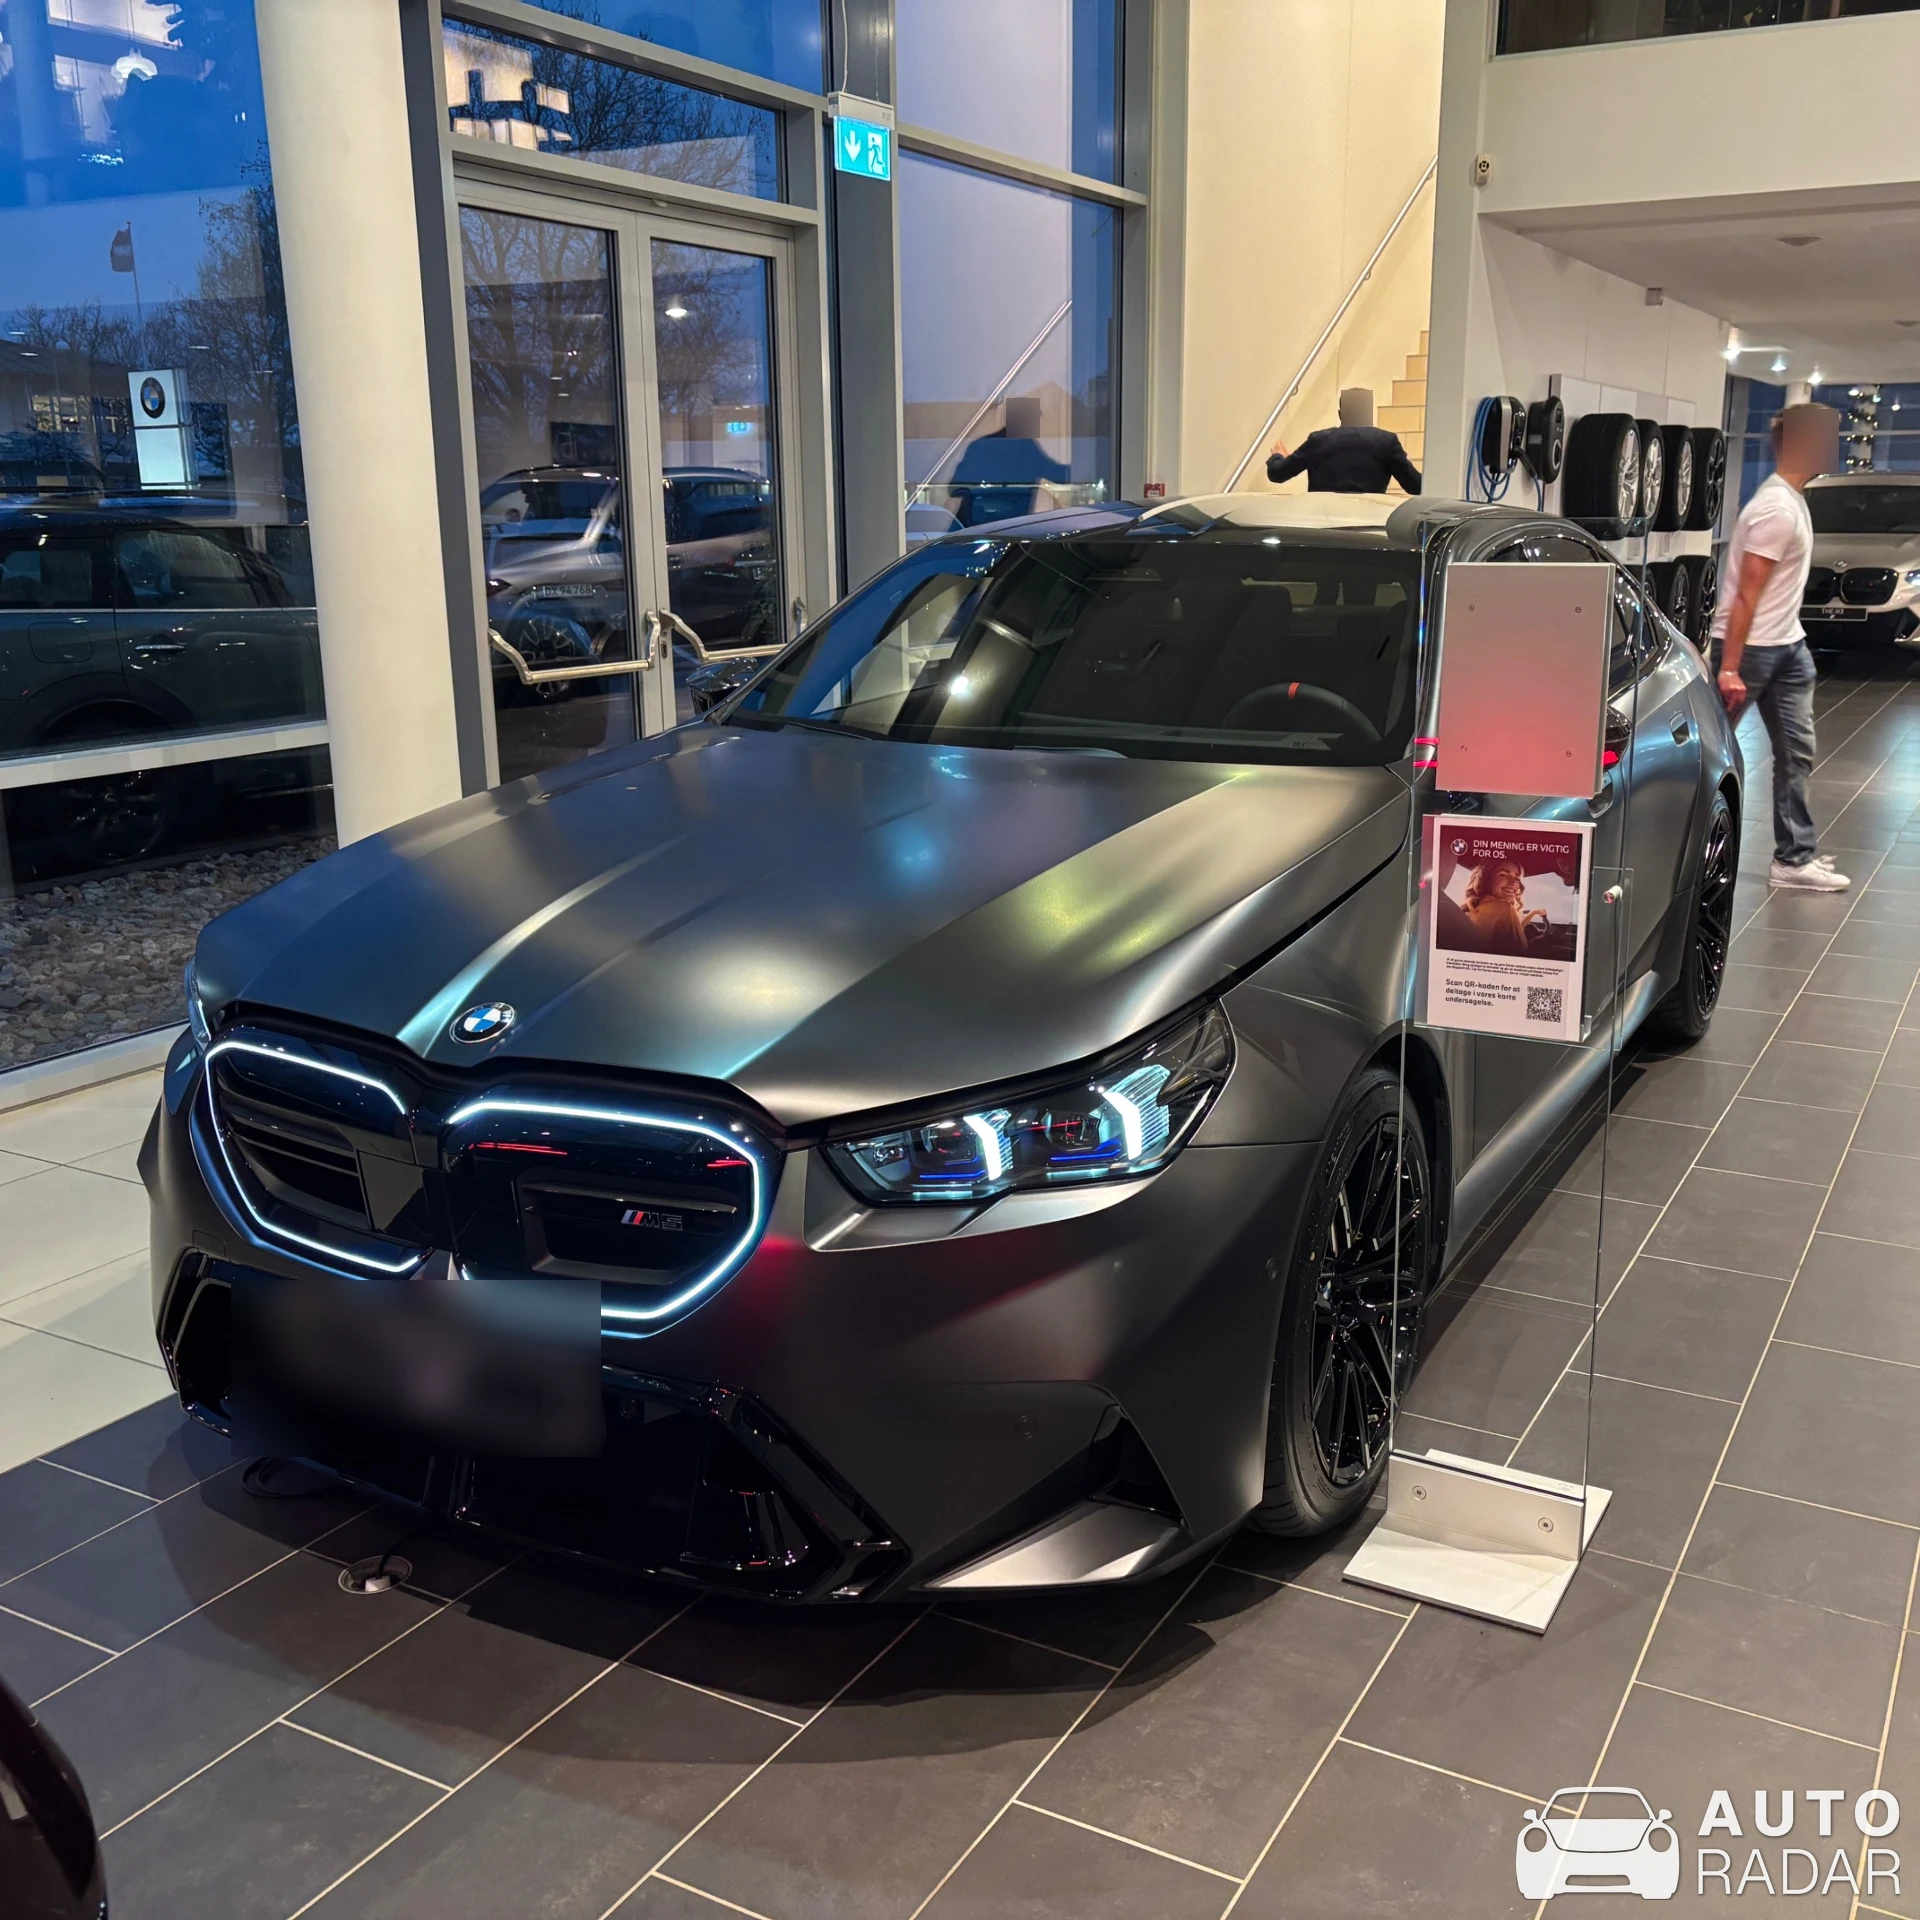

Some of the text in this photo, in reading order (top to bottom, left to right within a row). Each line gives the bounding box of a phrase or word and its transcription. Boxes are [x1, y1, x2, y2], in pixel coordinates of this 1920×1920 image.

[1473, 840, 1488, 849] DIN
[1490, 841, 1525, 851] MENING
[1527, 843, 1539, 852] ER
[1540, 844, 1570, 854] VIGTIG
[1473, 849, 1508, 859] FOR OS.
[1445, 988, 1472, 996] deltage
[1501, 984, 1512, 992] for
